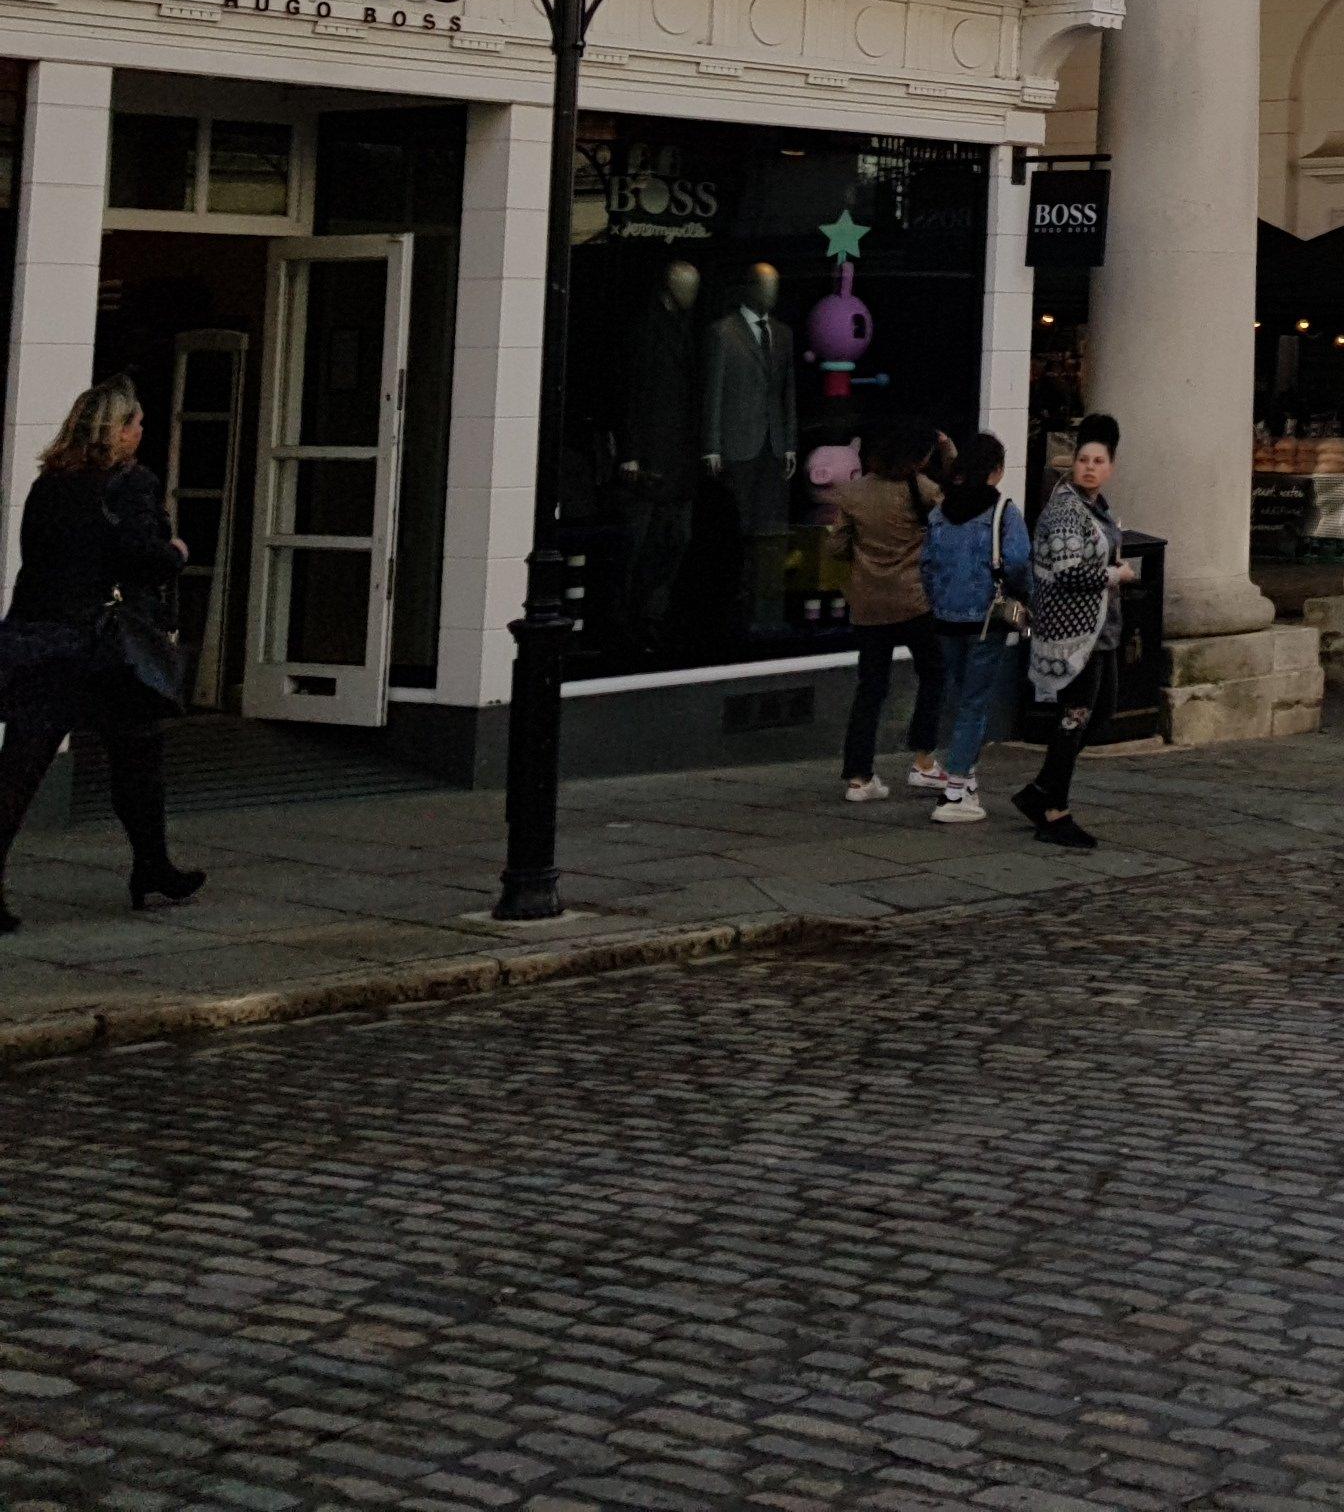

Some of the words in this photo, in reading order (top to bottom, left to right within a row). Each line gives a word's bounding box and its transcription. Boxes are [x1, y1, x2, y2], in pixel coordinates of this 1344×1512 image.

[363, 6, 462, 32] BOSS
[1034, 203, 1097, 226] BOSS
[1068, 226, 1096, 234] BOSS
